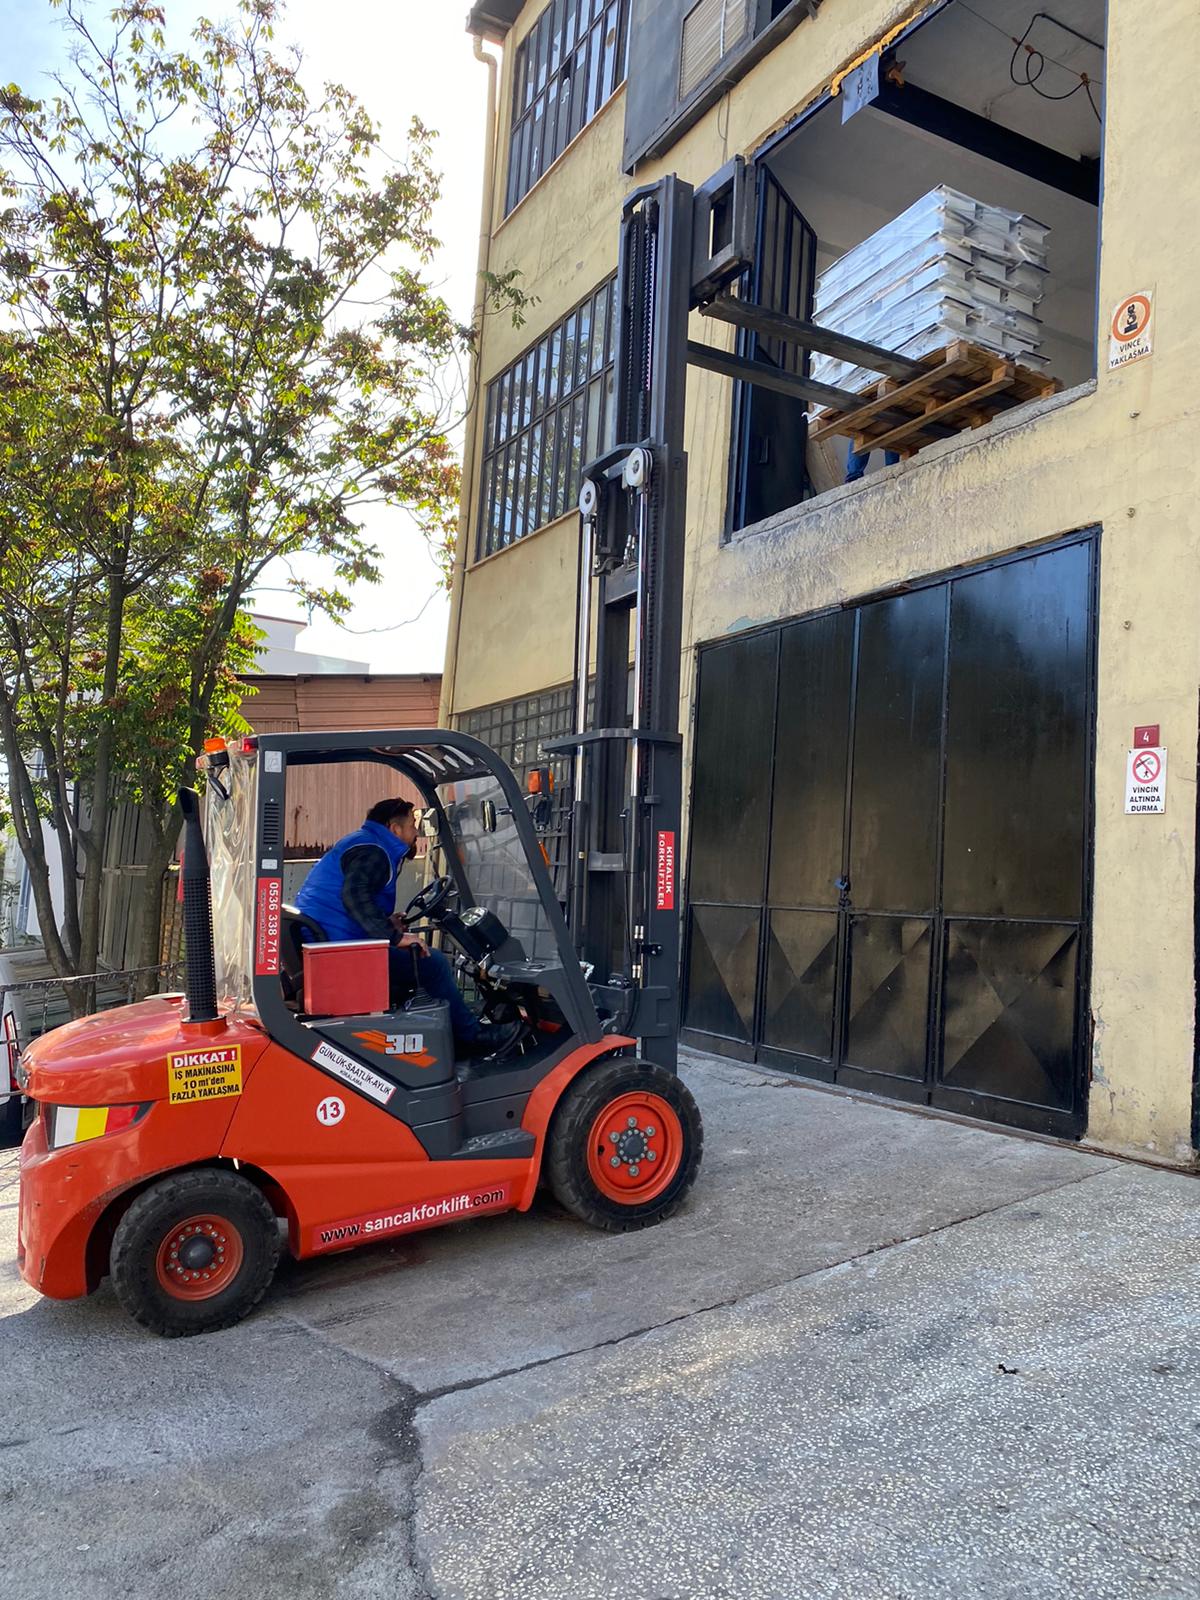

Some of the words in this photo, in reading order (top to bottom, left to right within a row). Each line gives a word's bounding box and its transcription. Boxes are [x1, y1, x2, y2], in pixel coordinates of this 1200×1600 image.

[1143, 731, 1149, 742] 4
[1129, 795, 1161, 803] ALTINDA
[268, 882, 279, 911] 0536
[267, 914, 278, 936] 338
[267, 939, 277, 953] 71
[266, 958, 277, 971] 71
[385, 1034, 424, 1055] 30
[173, 1051, 227, 1068] DİKKAT
[185, 1063, 236, 1078] MAKİNASINA
[171, 1090, 196, 1101] FAZLA
[198, 1084, 240, 1097] YAKLAŞMA
[183, 1080, 197, 1090] 10
[319, 1101, 341, 1120] 13
[320, 1189, 505, 1243] www.sancakforklift.com
